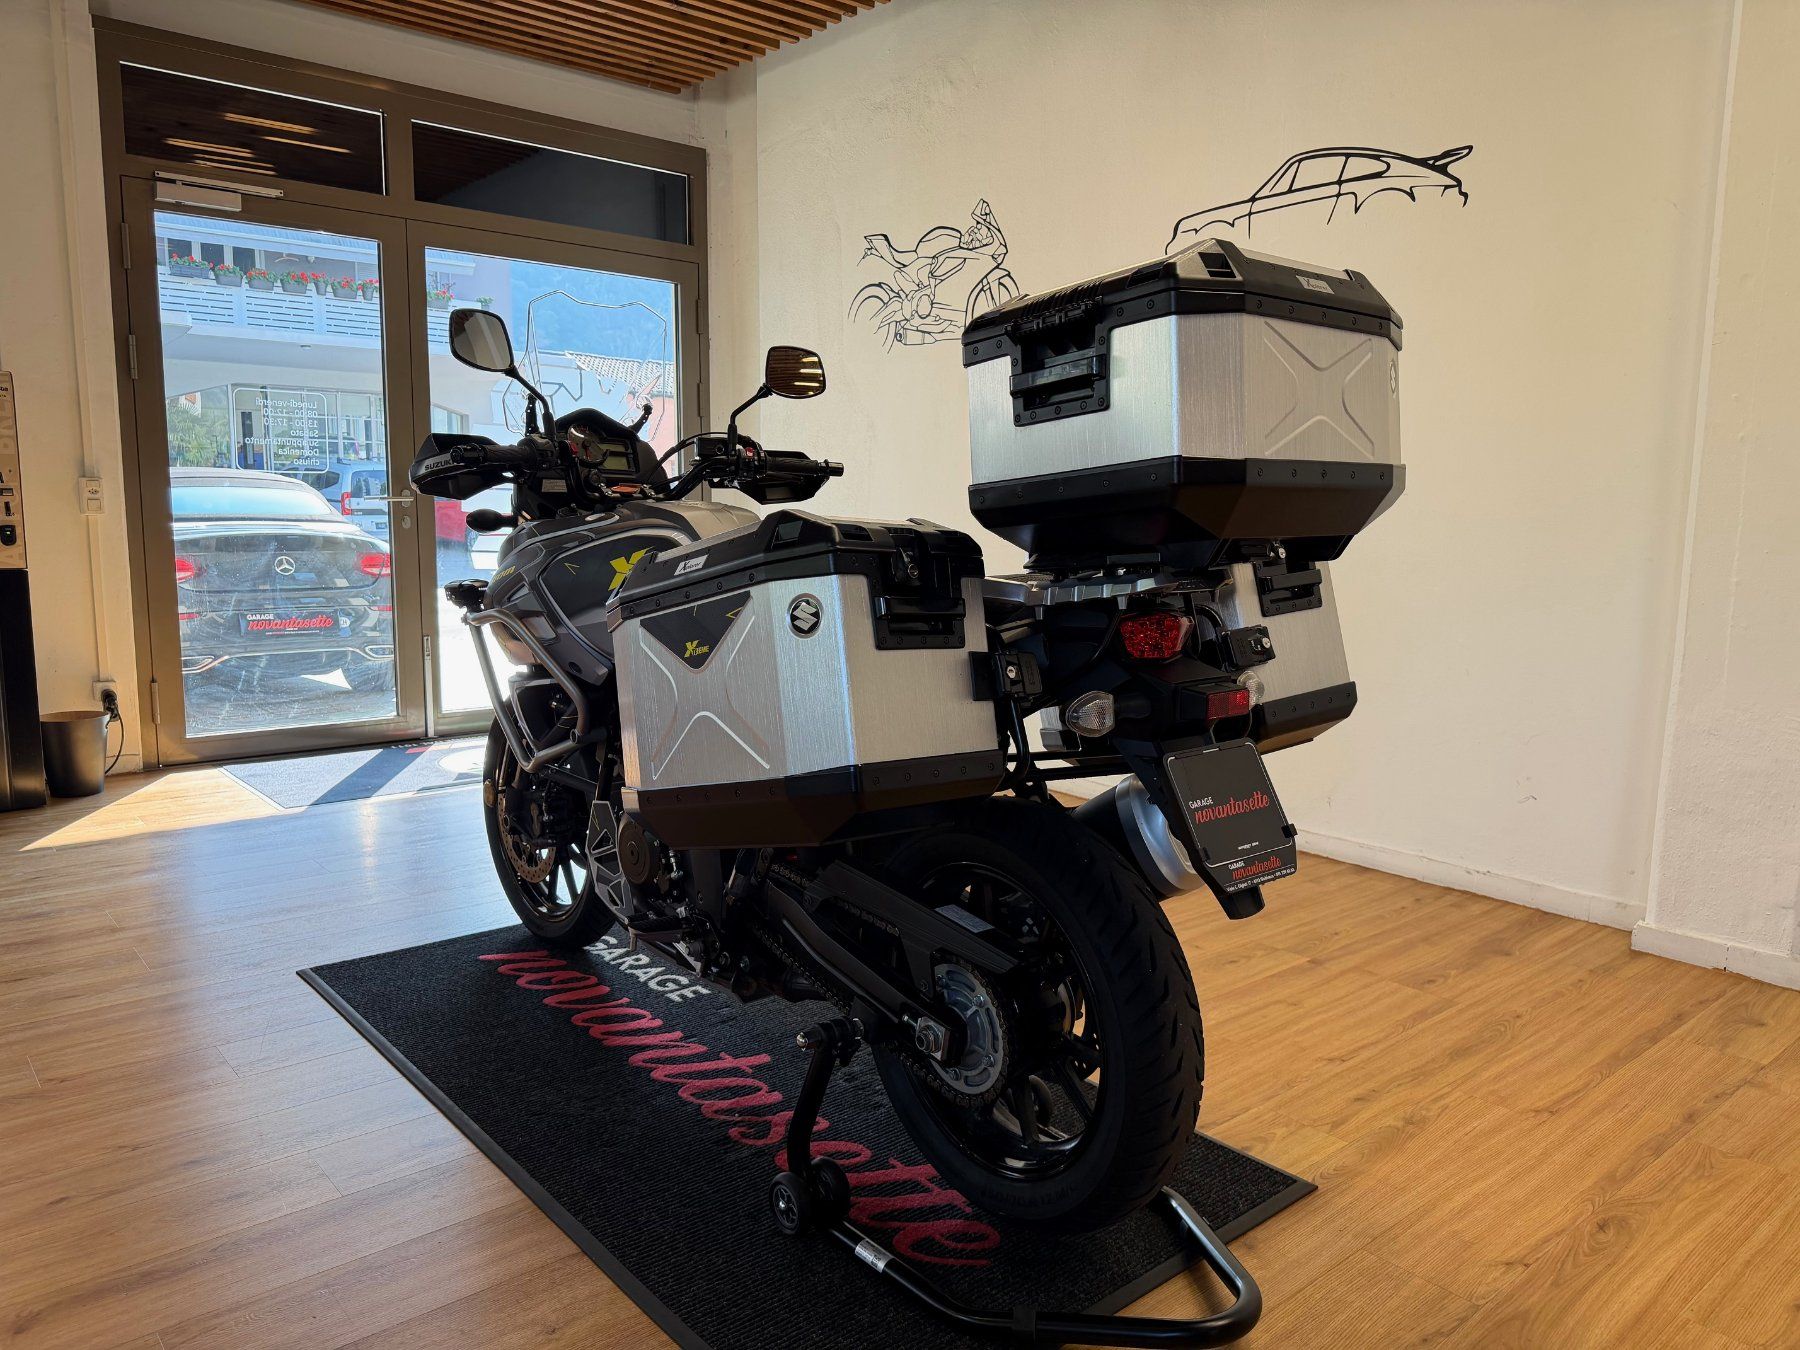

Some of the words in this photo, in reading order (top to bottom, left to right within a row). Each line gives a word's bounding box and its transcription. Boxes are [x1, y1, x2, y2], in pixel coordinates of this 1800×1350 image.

[424, 460, 451, 471] SUZUK
[248, 615, 334, 631] novantasette
[1189, 796, 1214, 810] GARAGE
[1194, 790, 1270, 825] novantasette
[1228, 861, 1246, 870] GARAGE
[1232, 855, 1282, 880] novantasette
[583, 935, 711, 1003] GARAGE
